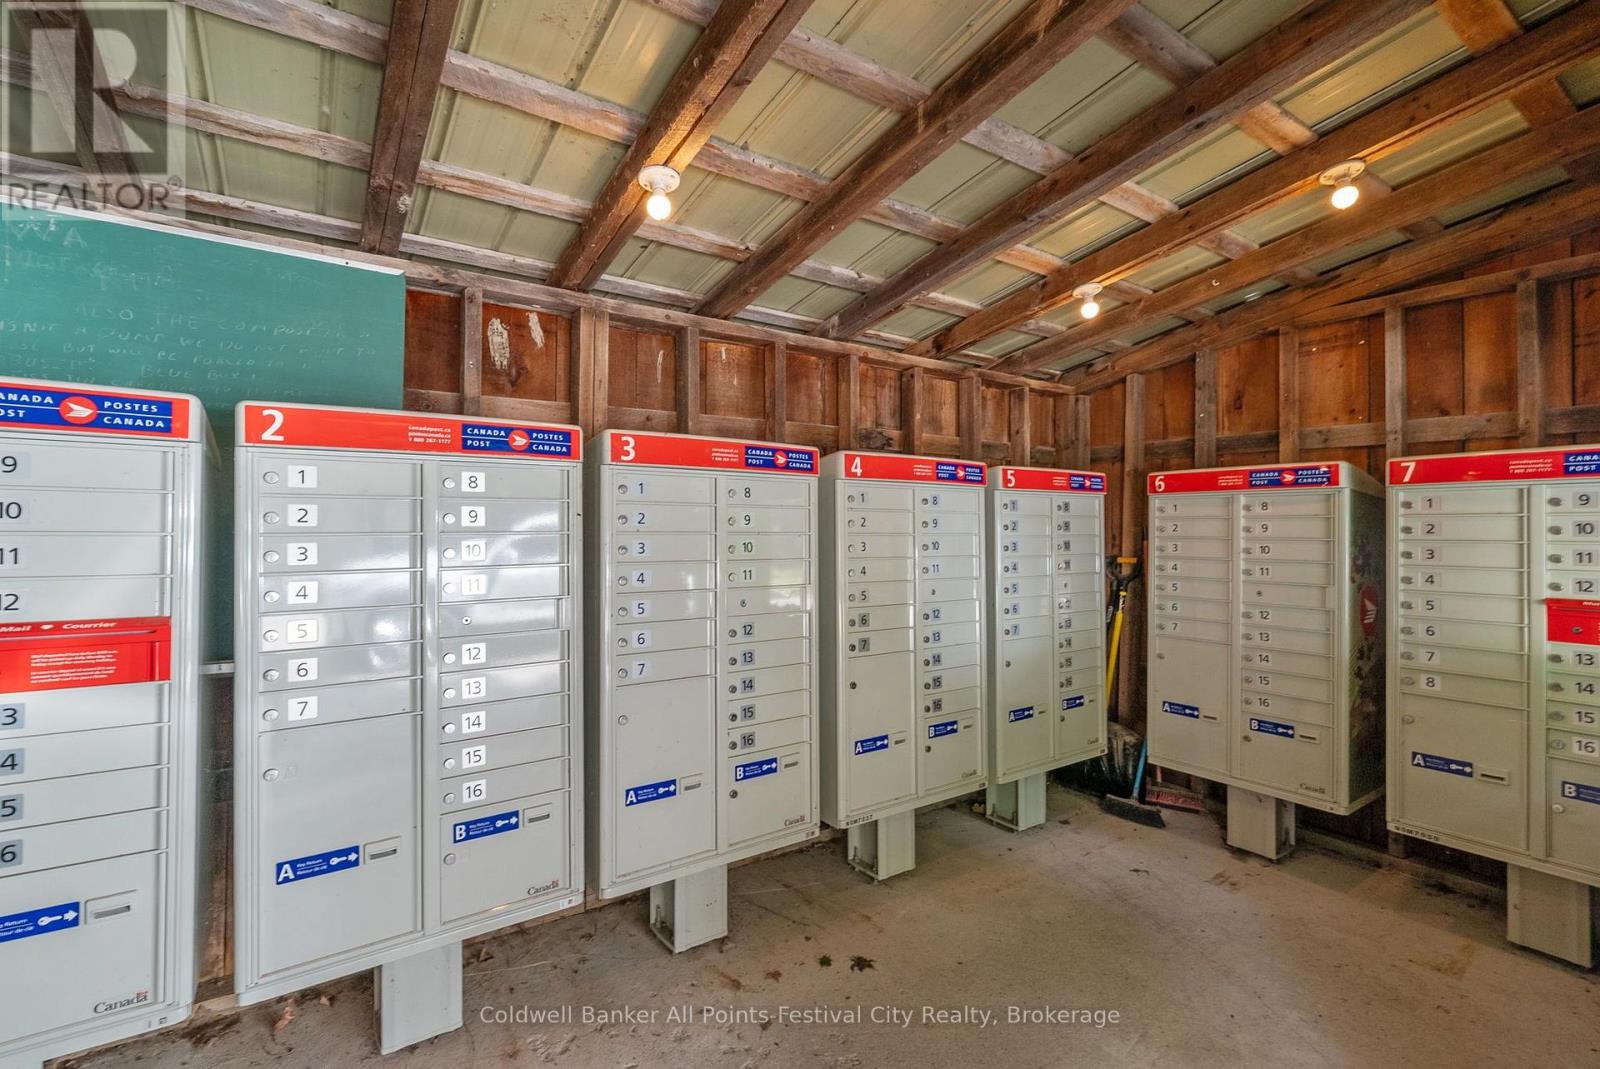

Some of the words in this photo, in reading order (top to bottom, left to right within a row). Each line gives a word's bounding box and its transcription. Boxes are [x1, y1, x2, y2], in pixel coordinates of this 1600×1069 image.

[103, 401, 159, 413] POSTES
[103, 416, 166, 428] CANADA
[261, 409, 284, 441] 2
[466, 427, 507, 438] CANADA
[532, 431, 564, 442] POSTES
[466, 439, 491, 449] POST
[532, 443, 568, 453] CANADA
[621, 436, 635, 461] 3
[747, 448, 773, 457] CANADA
[788, 452, 809, 460] POSTES
[1, 456, 17, 473] 9
[788, 461, 812, 469] CANADA
[851, 457, 862, 476] 4
[298, 470, 304, 484] 1
[1401, 461, 1416, 482] 7
[468, 475, 478, 489] 8
[1007, 470, 1015, 487] 5
[1155, 476, 1165, 492] 6
[638, 482, 643, 494] 1
[744, 487, 751, 498] 8
[860, 493, 865, 503] 1
[932, 496, 938, 506] 8
[1426, 498, 1433, 508] 1
[1578, 494, 1590, 506] 9
[1173, 504, 1177, 512] 1
[1261, 501, 1268, 511] 8
[297, 508, 308, 523] 2
[468, 509, 478, 523] 9
[638, 512, 645, 524] 2
[744, 514, 751, 526] 9
[861, 517, 866, 527] 2
[932, 518, 938, 528] 9
[1172, 524, 1178, 532] 2
[1261, 523, 1268, 533] 9
[1426, 523, 1435, 534] 2
[1575, 523, 1594, 535] 10
[465, 544, 481, 556] 10
[638, 542, 645, 554] 3
[742, 541, 753, 553] 10
[861, 541, 866, 552] 3
[931, 541, 940, 551] 10
[1172, 543, 1178, 552] 3
[1259, 545, 1270, 555] 10
[297, 546, 308, 562] 3
[1426, 549, 1435, 560] 3
[1576, 552, 1592, 564] 11
[860, 566, 866, 576] 4
[932, 564, 939, 573] 11
[1171, 563, 1178, 571] 4
[1260, 567, 1269, 576] 11
[636, 572, 645, 584] 4
[743, 569, 752, 580] 11
[1425, 575, 1435, 585] 4
[468, 578, 480, 592] 11
[1172, 583, 1178, 592] 5
[1575, 580, 1594, 593] 12
[295, 585, 308, 600] 4
[861, 590, 867, 601] 5
[638, 602, 645, 615] 5
[1171, 603, 1178, 611] 6
[1426, 600, 1435, 611] 5
[860, 614, 868, 626] 6
[932, 609, 940, 619] 12
[1259, 610, 1270, 620] 12
[62, 620, 118, 630] Courrier
[297, 623, 308, 639] 5
[742, 624, 753, 636] 12
[1172, 622, 1178, 631] 7
[1426, 626, 1435, 636] 6
[637, 633, 645, 645] 6
[932, 631, 941, 642] 13
[1258, 632, 1270, 642] 13
[861, 639, 868, 650] 7
[466, 647, 481, 660] 12
[742, 651, 754, 663] 13
[1258, 654, 1269, 663] 14
[1425, 651, 1435, 662] 7
[1576, 653, 1595, 666] 13
[932, 654, 941, 666] 14
[297, 662, 308, 678] 6
[637, 663, 645, 675] 7
[742, 679, 754, 691] 14
[932, 676, 942, 689] 15
[1258, 676, 1270, 686] 15
[1426, 677, 1435, 688] 8
[465, 681, 482, 695] 13
[1575, 682, 1595, 695] 14
[932, 698, 942, 712] 16
[1163, 703, 1170, 712] A
[1258, 697, 1270, 707] 16
[297, 701, 308, 716] 7
[742, 706, 754, 719] 15
[465, 715, 482, 729] 14
[1575, 711, 1595, 724] 15
[1251, 720, 1258, 729] B
[929, 727, 935, 737] B
[741, 734, 754, 747] 16
[1576, 740, 1596, 753] 16
[855, 742, 863, 753] A
[465, 749, 482, 764] 15
[1413, 754, 1425, 766] A
[737, 767, 744, 779] B
[465, 783, 482, 799] 16
[1564, 784, 1576, 797] B
[626, 790, 637, 804] A
[456, 825, 466, 841] B
[278, 864, 295, 882] A
[93, 992, 148, 1014] Canada
